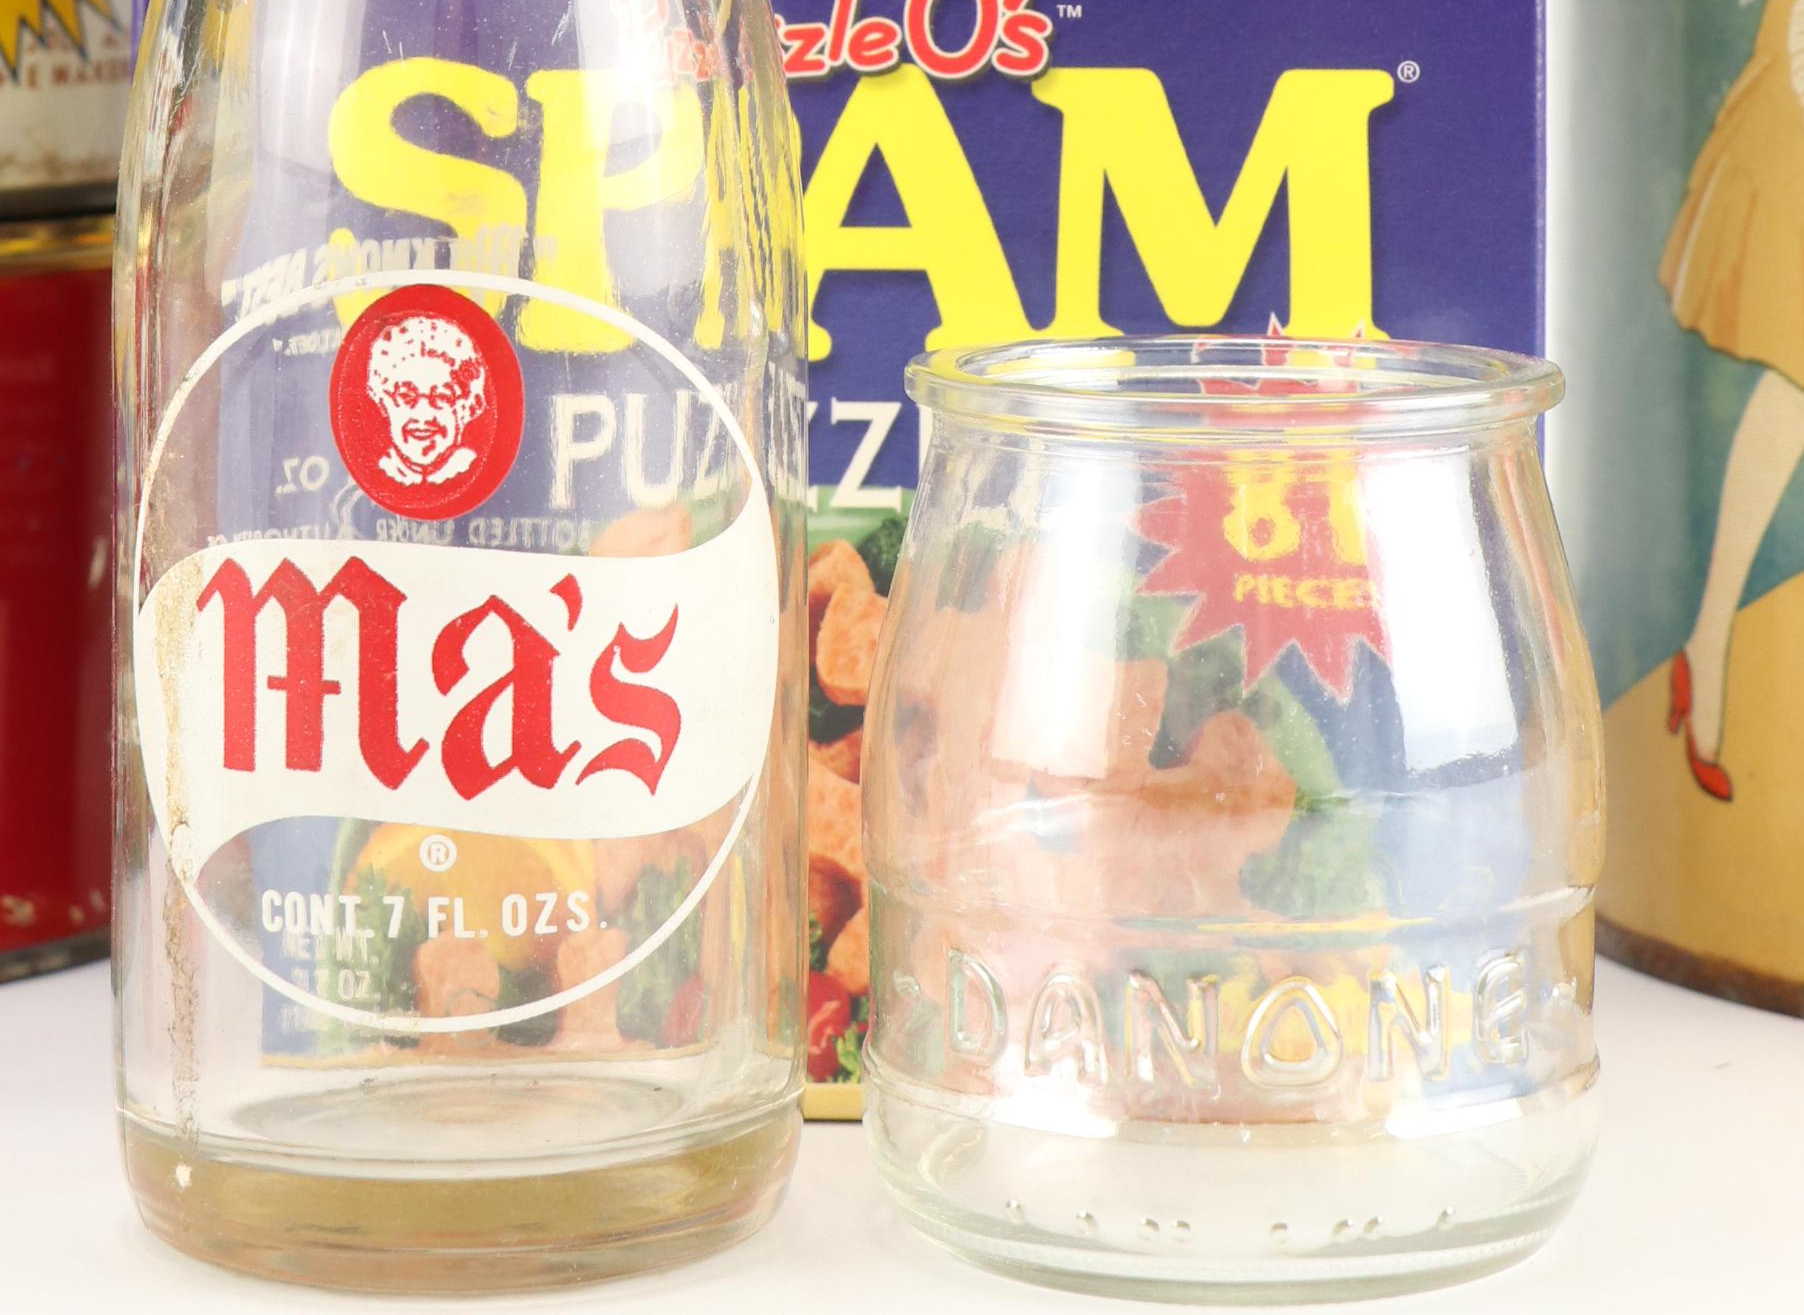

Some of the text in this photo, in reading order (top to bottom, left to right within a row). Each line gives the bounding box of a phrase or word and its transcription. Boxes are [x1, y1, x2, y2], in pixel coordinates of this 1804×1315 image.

[196, 554, 682, 801] Ma's
[262, 889, 608, 939] CONT. 7 FL. OZS.
[946, 947, 1529, 1087] DANONE
